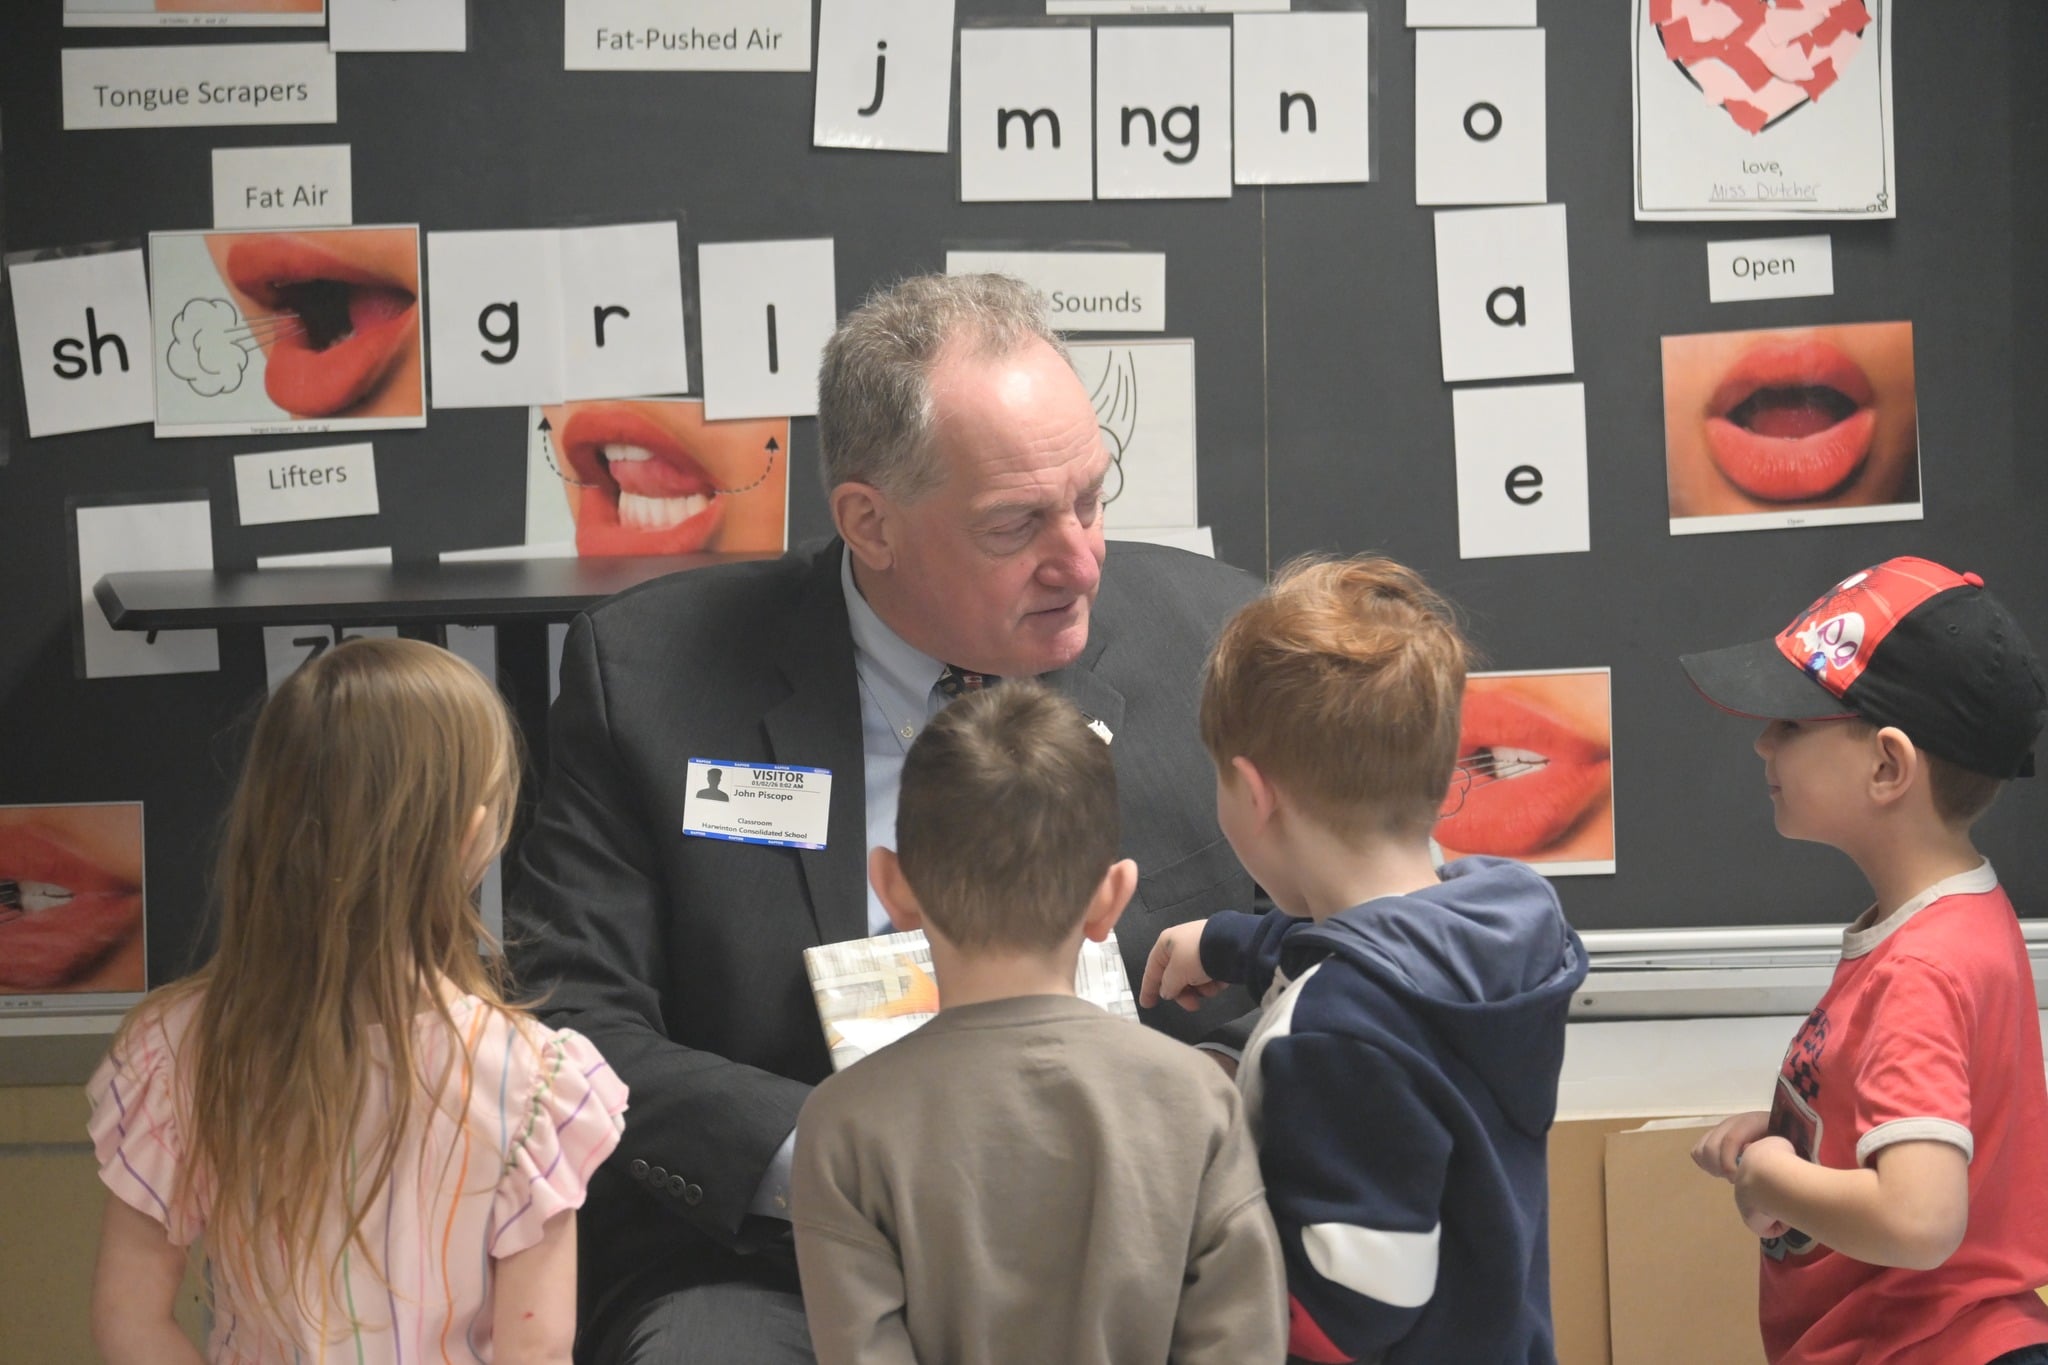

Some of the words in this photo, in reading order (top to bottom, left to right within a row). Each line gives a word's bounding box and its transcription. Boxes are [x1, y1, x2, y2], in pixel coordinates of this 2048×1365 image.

[596, 27, 737, 50] Fat-Pushed
[746, 28, 782, 50] Air
[857, 40, 888, 117] j
[93, 85, 189, 111] Tongue
[198, 82, 308, 107] Scrapers
[1279, 91, 1317, 134] n
[1462, 101, 1503, 143] o
[997, 107, 1061, 150] m
[1120, 104, 1200, 165] ng
[1742, 159, 1783, 177] Love,
[245, 187, 284, 209] Fat
[292, 184, 329, 207] Air
[1711, 181, 1746, 199] Miss
[1757, 181, 1821, 200] Dutcher
[1732, 257, 1795, 281] Open
[1052, 290, 1142, 313] Sounds
[1485, 285, 1527, 327] a
[477, 301, 520, 365] g
[593, 305, 630, 348] r
[52, 306, 130, 380] sh
[268, 465, 347, 490] Lifters
[1504, 464, 1544, 506] e
[753, 769, 804, 783] VISITOR
[733, 789, 756, 798] John
[758, 791, 793, 802] Piscopo
[702, 822, 737, 833] Harwinton
[739, 827, 783, 838] Consolidated
[784, 831, 808, 839] School
[737, 818, 773, 827] Classroom
